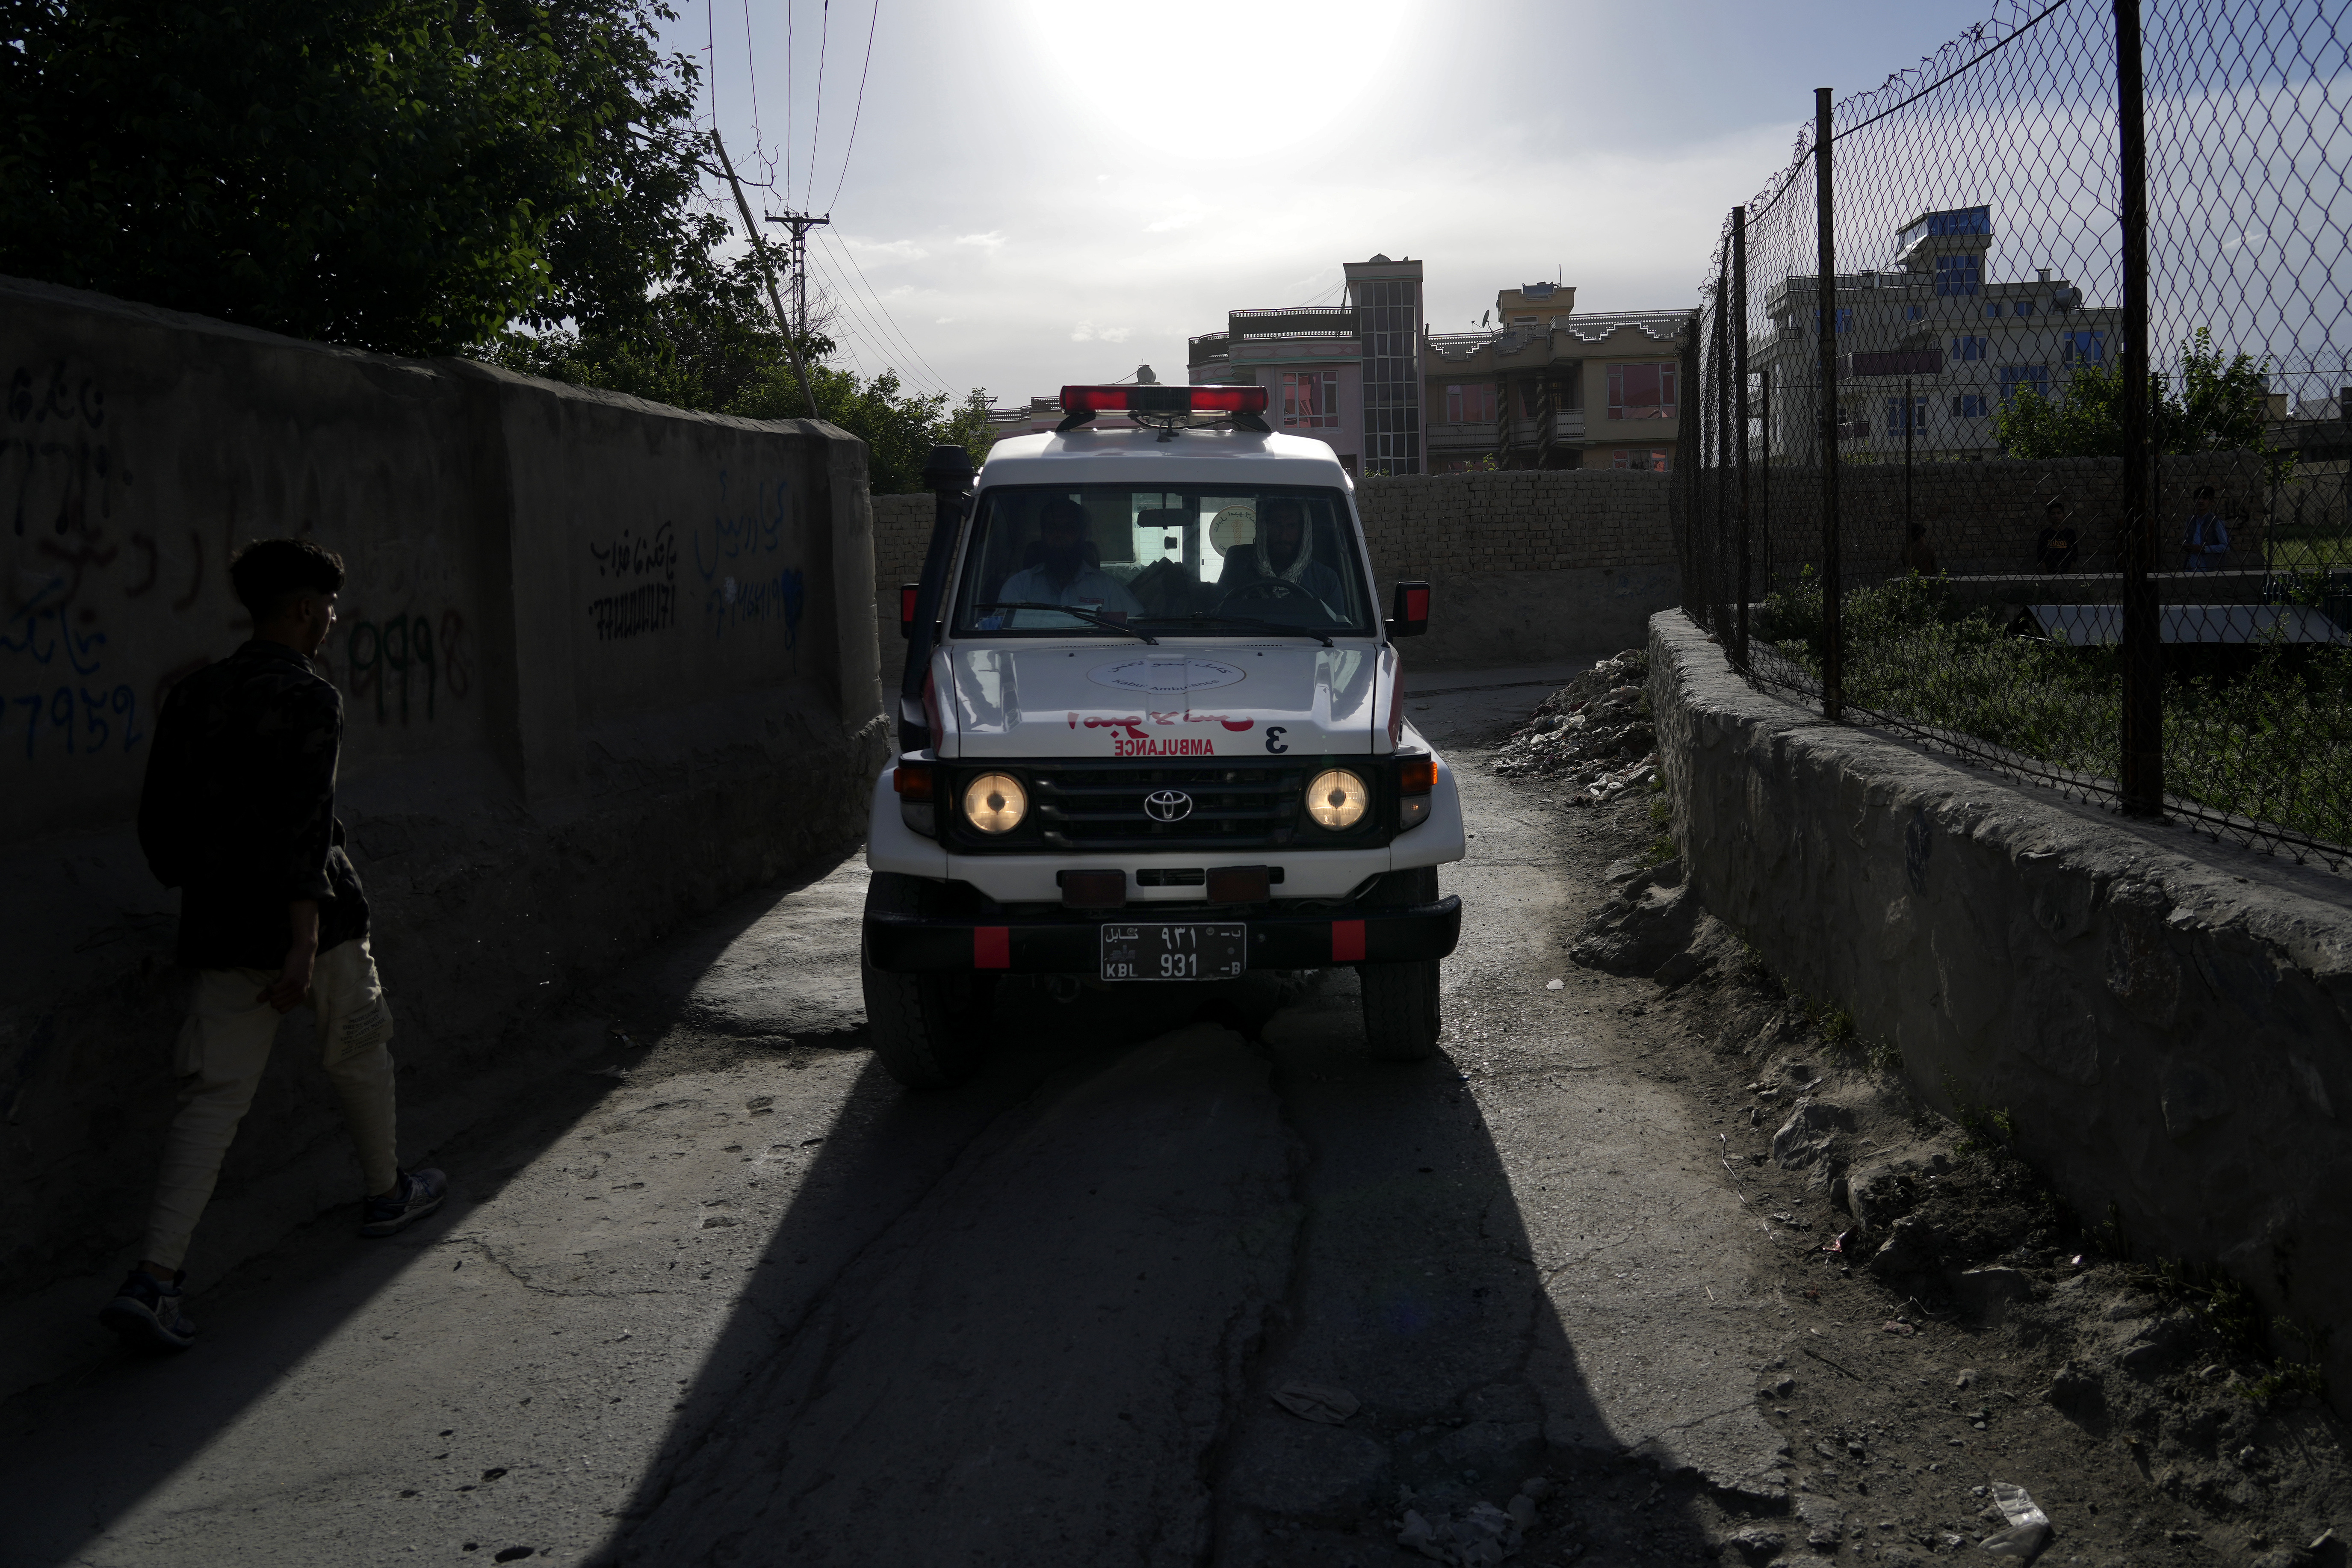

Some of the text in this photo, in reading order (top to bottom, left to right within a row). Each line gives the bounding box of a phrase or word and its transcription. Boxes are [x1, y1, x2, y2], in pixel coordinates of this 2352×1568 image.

[1161, 926, 1197, 950] ۹۳۱
[1106, 963, 1139, 977] KBL
[1160, 953, 1197, 977] 931
[363, 1015, 380, 1027] NIGHT
[355, 1027, 370, 1038] PARTY
